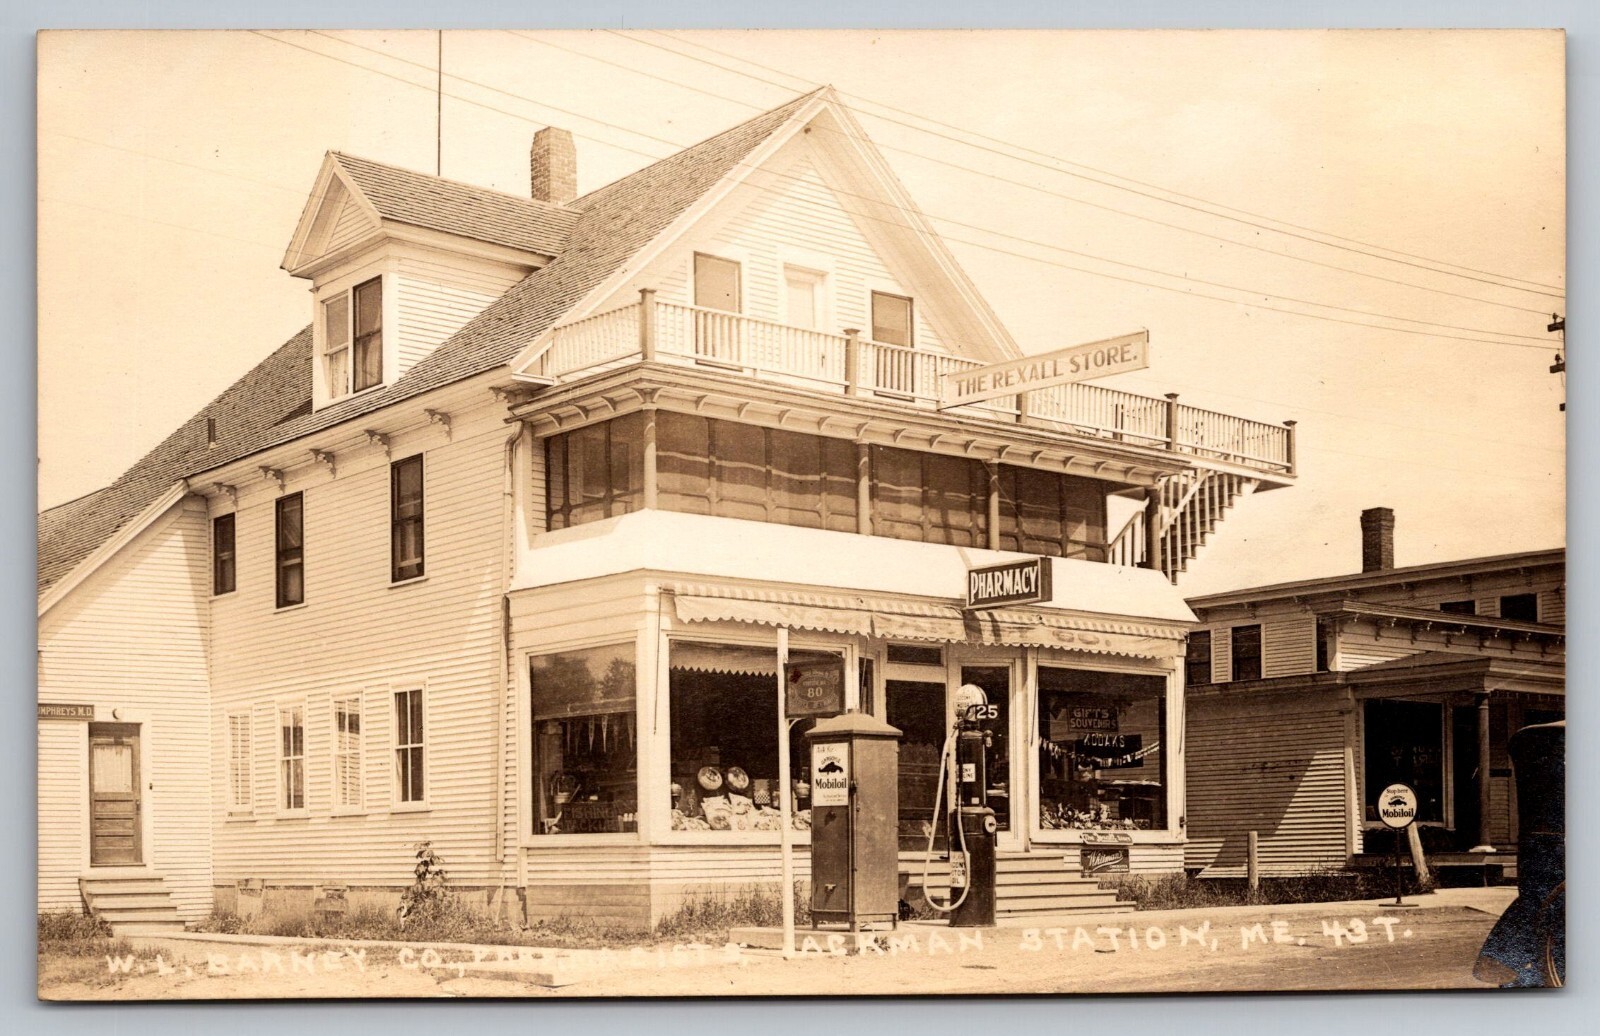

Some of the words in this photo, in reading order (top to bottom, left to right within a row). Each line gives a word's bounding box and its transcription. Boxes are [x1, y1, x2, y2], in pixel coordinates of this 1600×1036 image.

[956, 376, 987, 398] THE
[992, 361, 1064, 390] REXALL
[1069, 342, 1138, 374] STORE.
[970, 566, 1039, 604] PHARMACY
[807, 686, 823, 698] 80
[976, 705, 998, 719] 25
[1073, 708, 1109, 719] GIFTS
[1083, 734, 1125, 748] KODAKS
[815, 778, 847, 790] Mobiloil
[1382, 807, 1415, 818] Mobiloil
